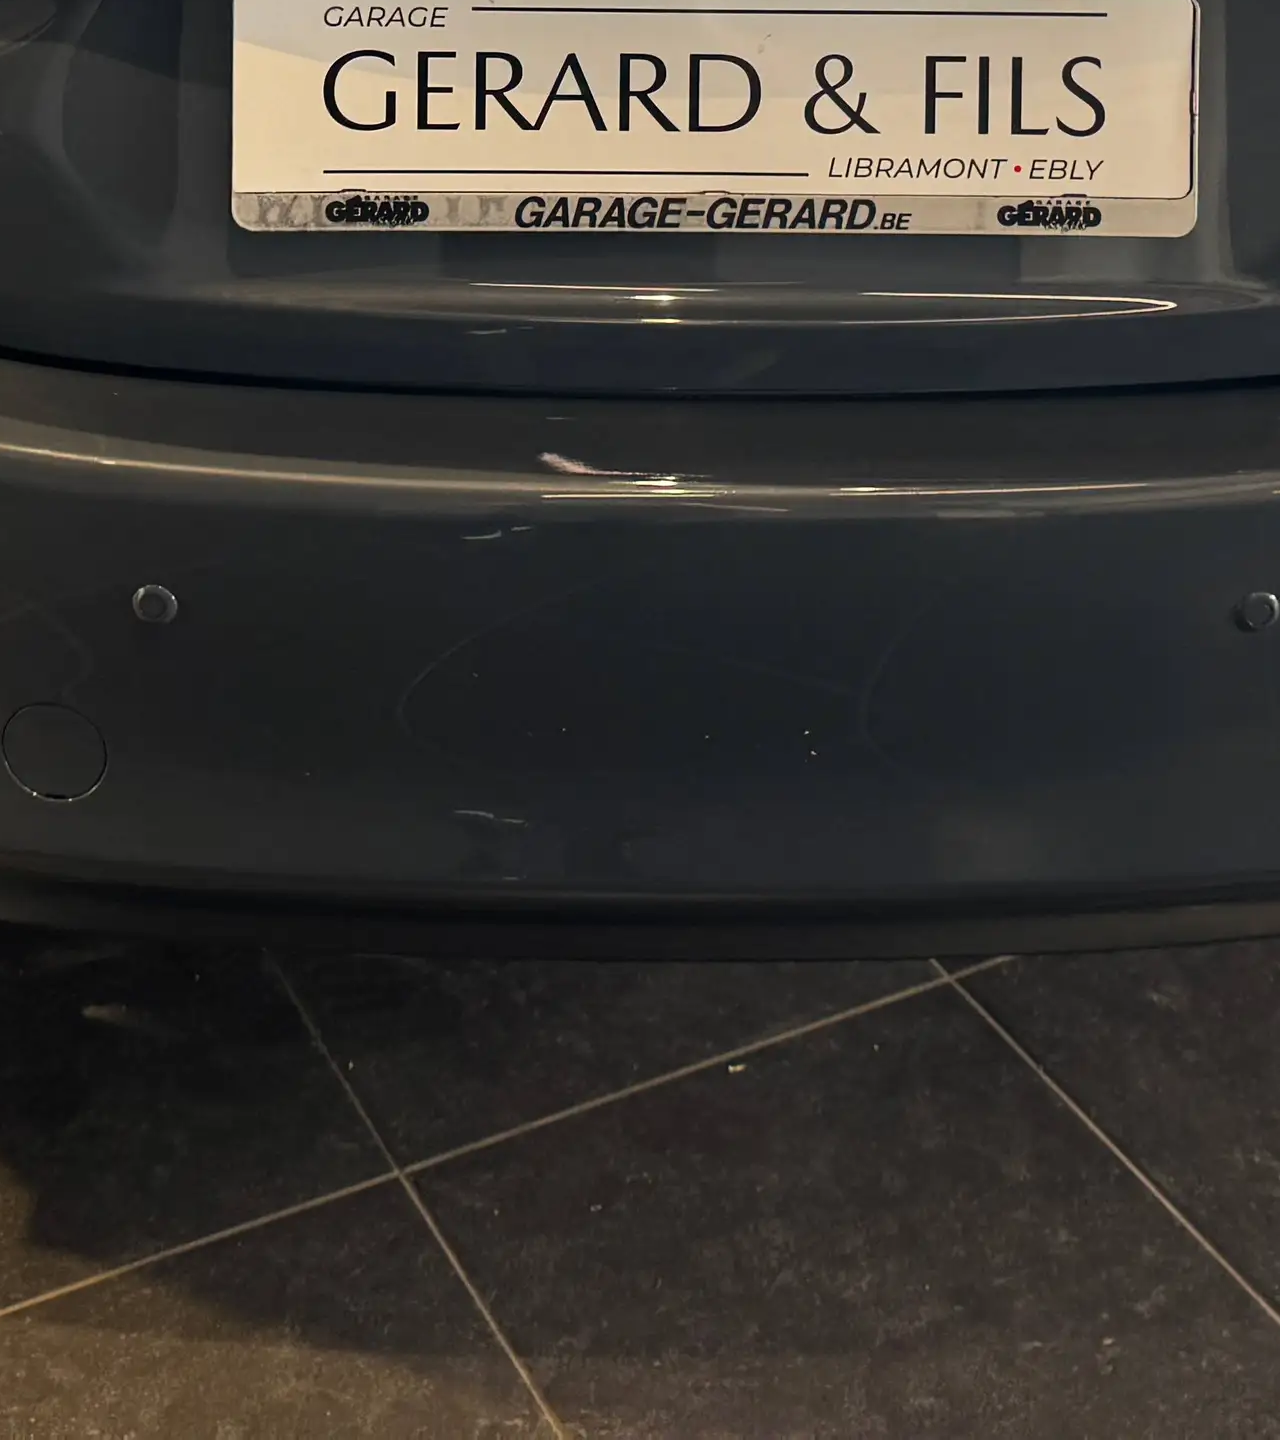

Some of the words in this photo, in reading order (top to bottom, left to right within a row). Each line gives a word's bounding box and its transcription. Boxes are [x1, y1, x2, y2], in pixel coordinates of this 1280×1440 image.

[323, 5, 449, 28] GARAGE
[322, 49, 762, 133] GERARD
[804, 53, 881, 135] &
[924, 55, 1106, 138] FILS
[828, 156, 1009, 180] LIBRAMONT
[1028, 159, 1105, 181] EBLY
